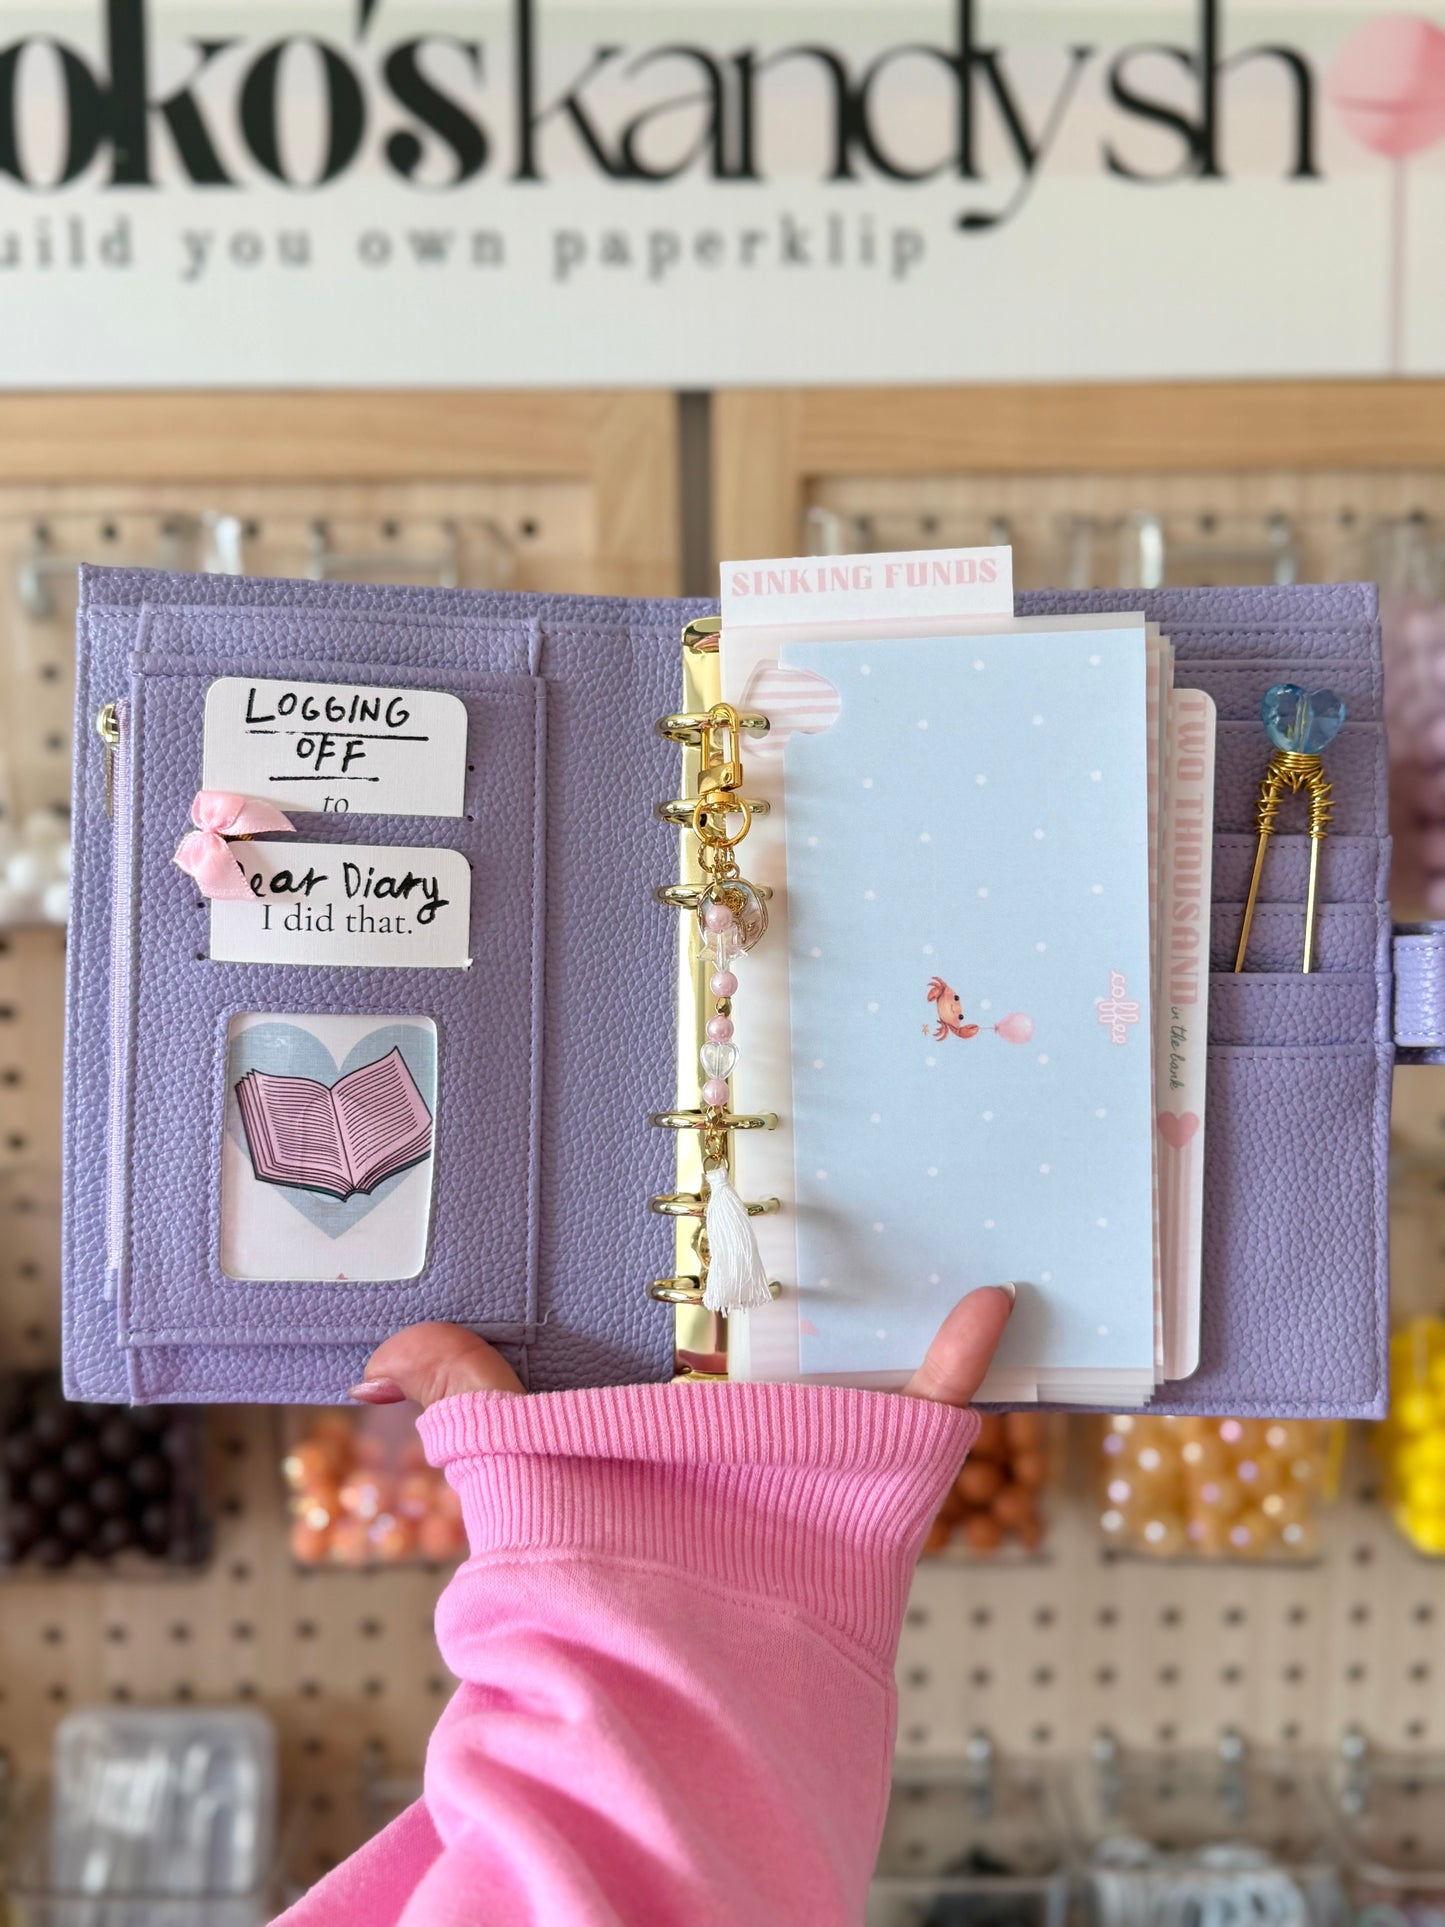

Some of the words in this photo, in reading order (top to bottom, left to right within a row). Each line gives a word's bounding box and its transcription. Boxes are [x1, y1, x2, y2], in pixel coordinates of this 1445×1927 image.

[180, 226, 314, 283] you
[358, 226, 505, 268] own
[553, 212, 925, 281] paperklip
[731, 564, 873, 597] SINKING
[885, 557, 998, 589] FUNDS
[245, 687, 411, 728] LOGGING
[296, 733, 367, 773] OFF
[1176, 696, 1208, 782] TWO
[323, 795, 350, 813] to
[236, 860, 329, 898] ear
[343, 861, 450, 925] Diary
[1169, 793, 1205, 1006] THOUSAND
[262, 903, 273, 931] I
[284, 902, 335, 933] did
[346, 904, 413, 935] that.
[1098, 970, 1140, 1045] coffee
[1170, 1006, 1183, 1020] in
[1170, 1025, 1188, 1050] the
[1169, 1053, 1186, 1091] bank
